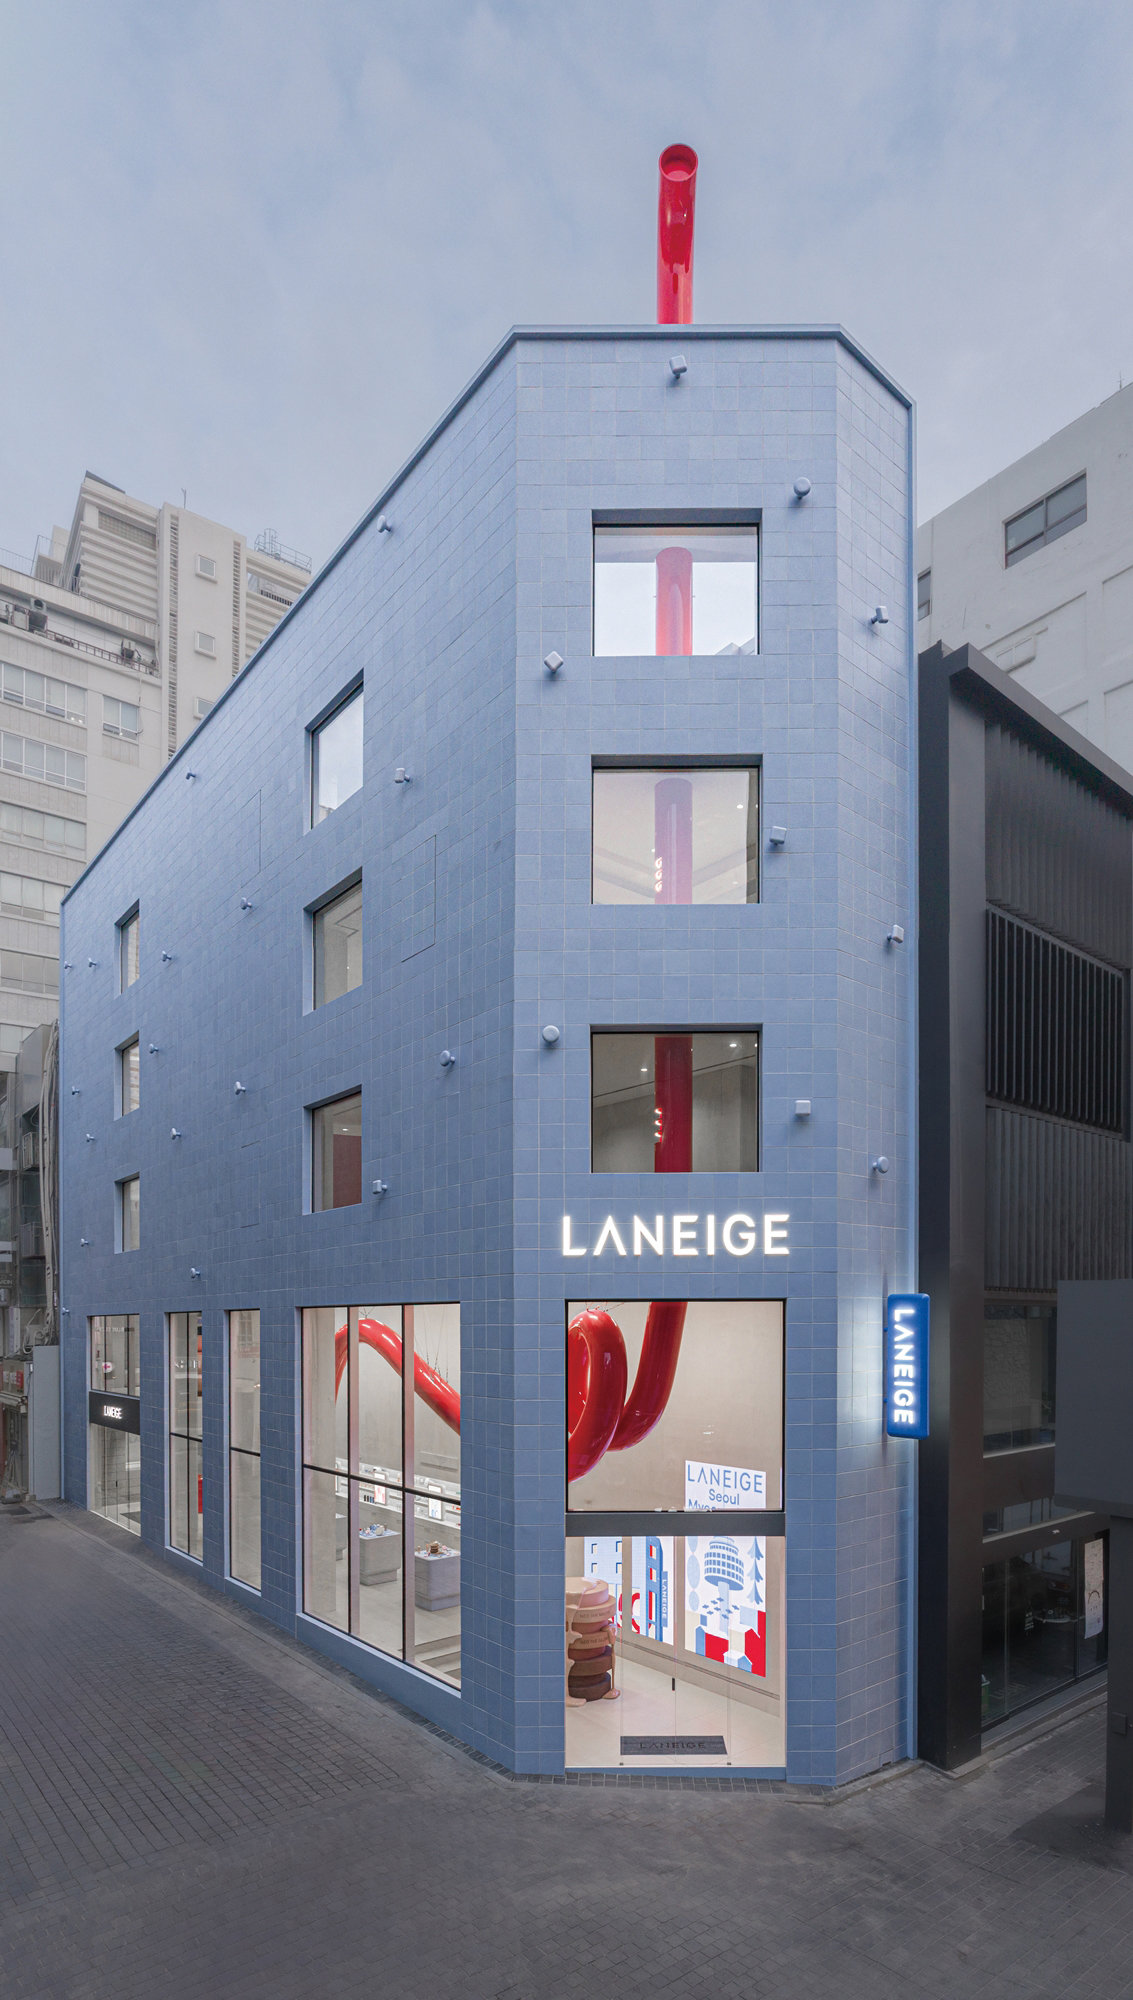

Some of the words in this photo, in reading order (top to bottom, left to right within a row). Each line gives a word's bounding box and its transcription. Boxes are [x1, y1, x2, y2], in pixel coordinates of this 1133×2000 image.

[562, 1214, 790, 1256] LANEIGE
[893, 1308, 915, 1425] LANEIGE
[687, 1464, 763, 1493] LANEIGE
[708, 1488, 740, 1505] Seoul
[640, 1742, 706, 1750] LANEIGE
